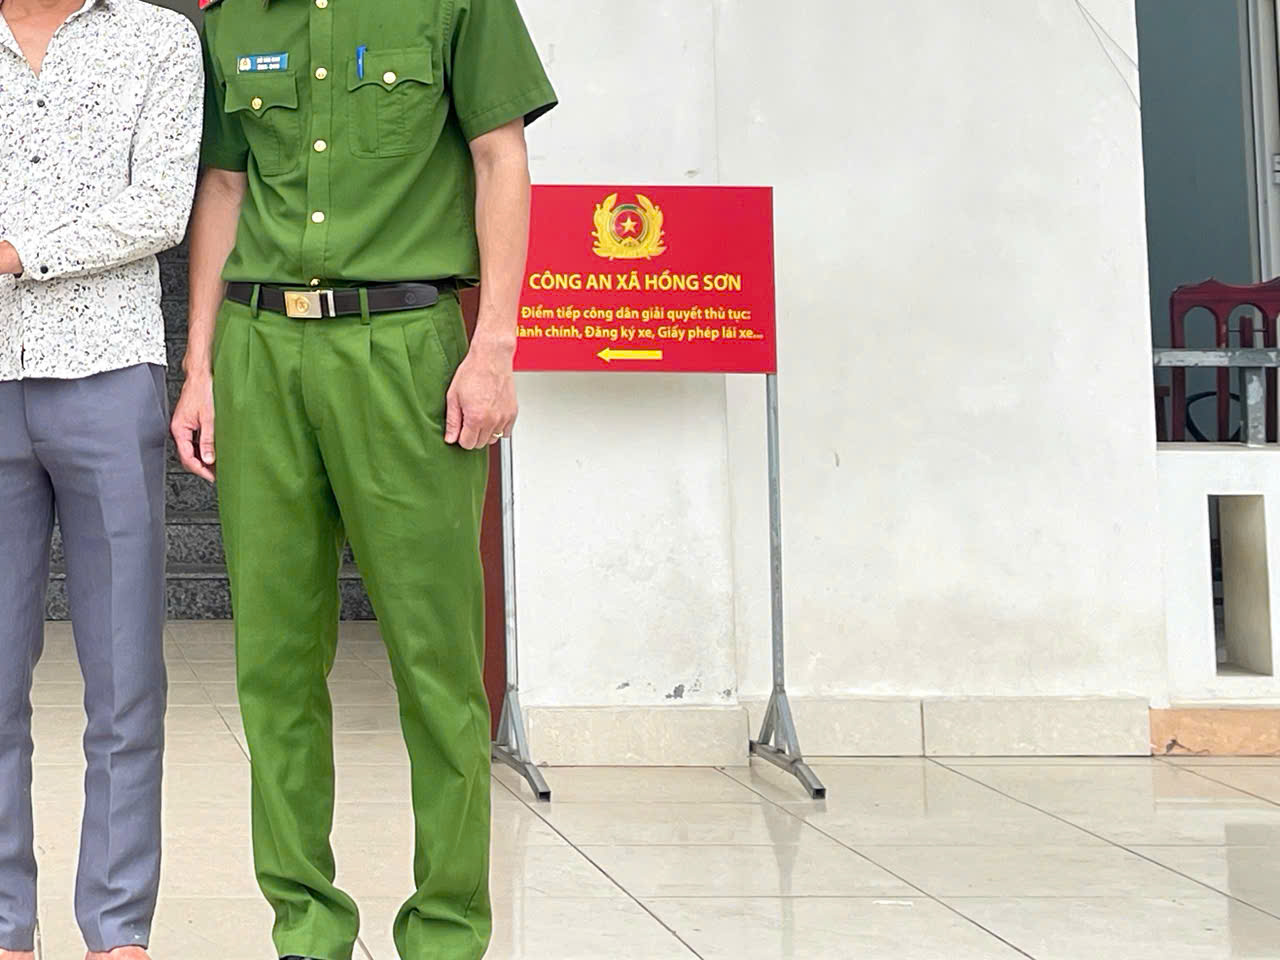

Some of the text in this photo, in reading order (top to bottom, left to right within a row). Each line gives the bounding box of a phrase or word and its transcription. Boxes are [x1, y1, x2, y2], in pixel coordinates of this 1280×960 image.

[529, 270, 581, 290] CÔNG
[586, 274, 612, 290] AN
[616, 270, 641, 290] XÃ
[703, 273, 741, 291] SƠN
[521, 304, 554, 319] Điểm
[556, 304, 581, 321] tiếp
[583, 306, 613, 322] công
[616, 306, 639, 319] dân
[642, 306, 664, 322] giải
[667, 304, 703, 323] quyết
[705, 306, 725, 320] thủ
[545, 325, 583, 339] chính,
[585, 326, 618, 341] Đăng
[621, 326, 635, 341] ký
[638, 328, 656, 340] xe,
[658, 325, 686, 342] Giấy
[688, 326, 720, 342] phép
[722, 326, 737, 339] lái
